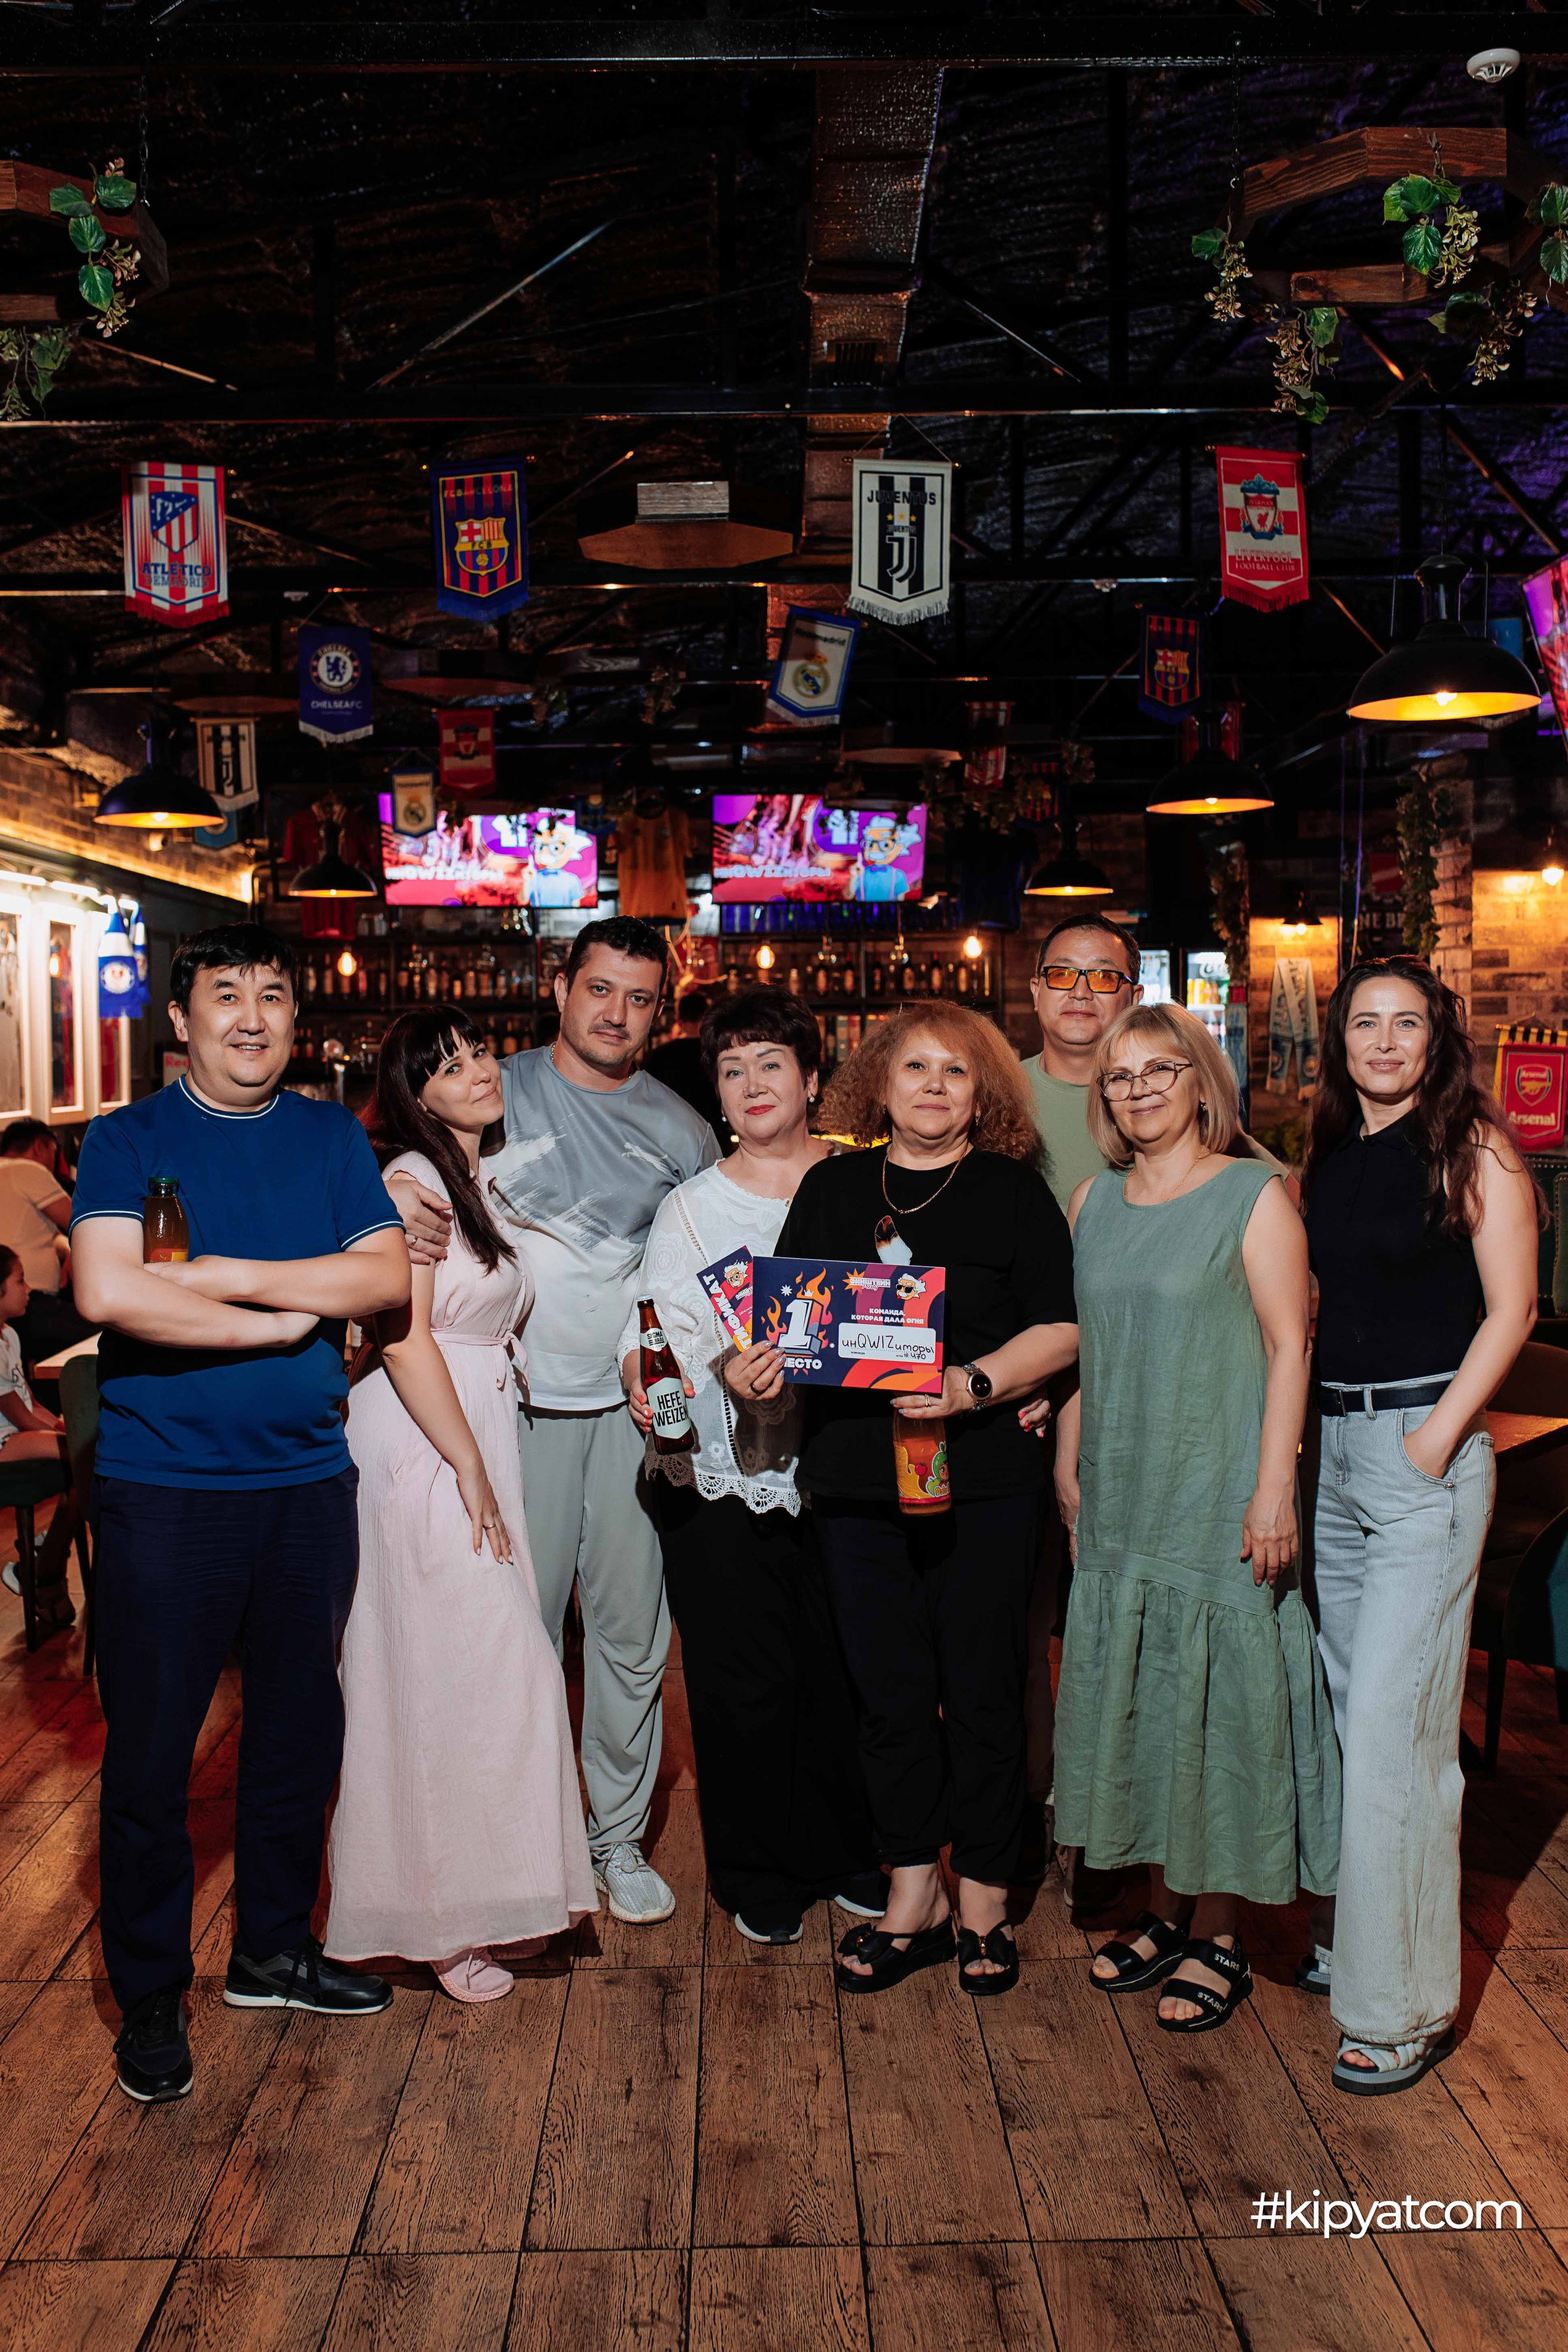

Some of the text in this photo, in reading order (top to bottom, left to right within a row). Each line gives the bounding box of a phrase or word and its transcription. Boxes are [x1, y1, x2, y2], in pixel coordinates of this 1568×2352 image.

[867, 490, 936, 505] JUVENTUS
[471, 540, 492, 549] FCB
[1234, 548, 1294, 564] LIVERPOOL
[141, 560, 212, 576] ATLÉTICO
[1235, 562, 1295, 572] FOOTBALL CLUB
[1521, 1070, 1547, 1079] Arsenal
[1509, 1110, 1556, 1126] Arsenal
[869, 1308, 907, 1316] КОМАНДА,
[777, 1298, 819, 1351] 1
[647, 1331, 663, 1340] SIGMA
[657, 1390, 682, 1410] HEFE
[654, 1406, 688, 1427] WEIZEN
[1214, 1953, 1240, 1971] STARS
[1197, 1991, 1225, 2013] STARS
